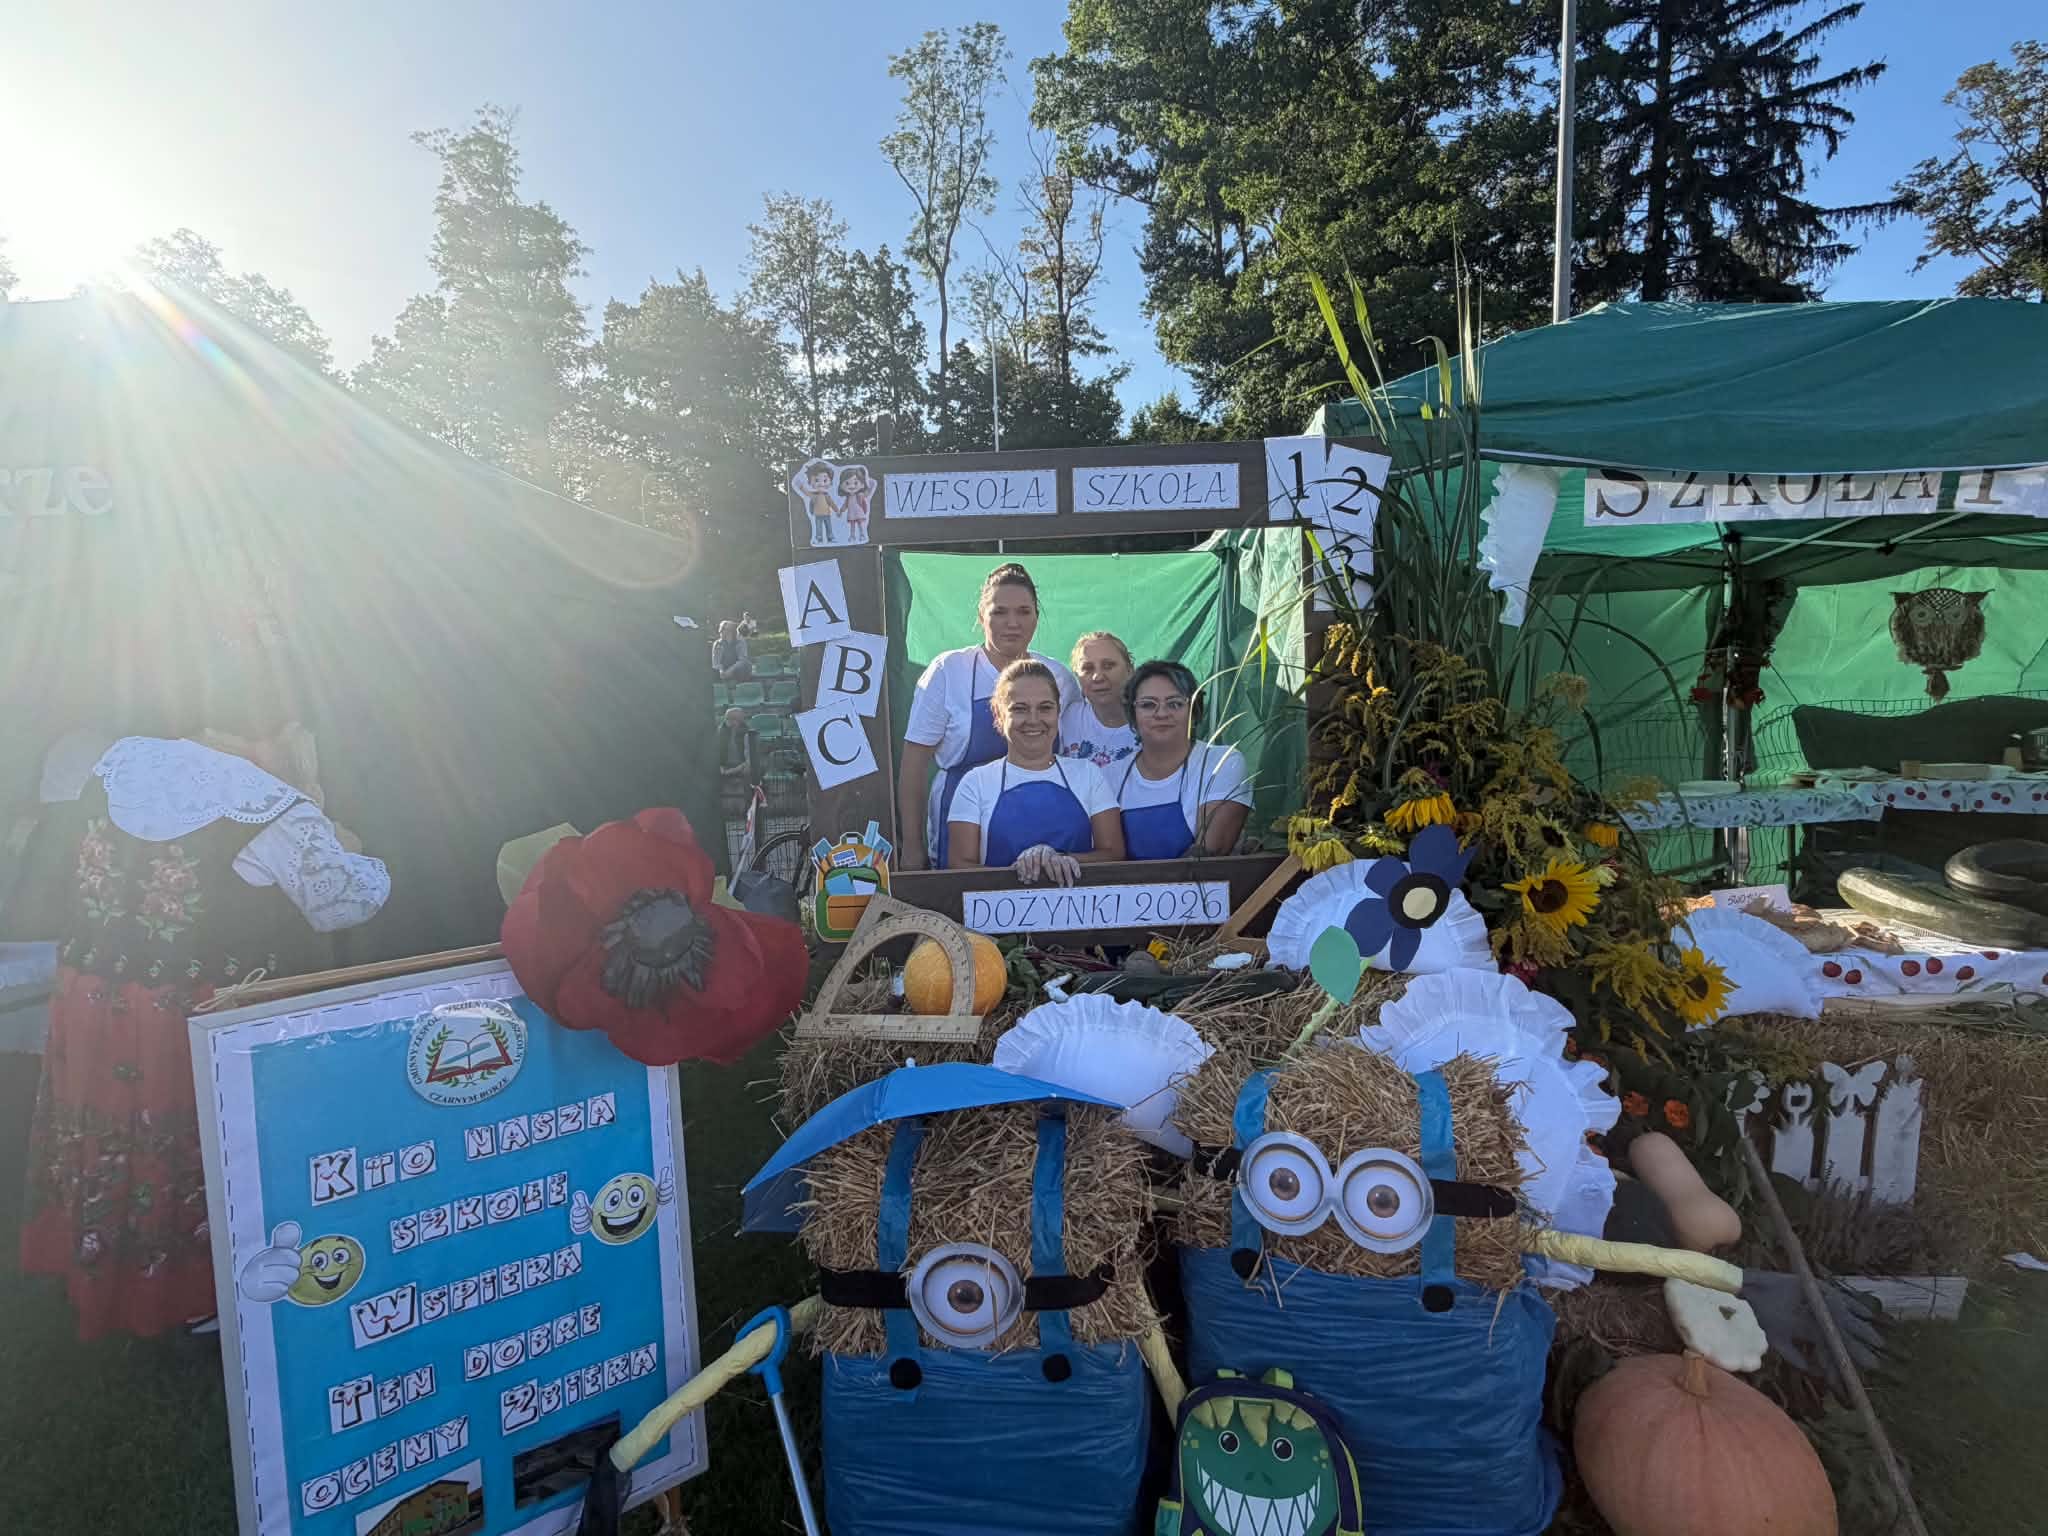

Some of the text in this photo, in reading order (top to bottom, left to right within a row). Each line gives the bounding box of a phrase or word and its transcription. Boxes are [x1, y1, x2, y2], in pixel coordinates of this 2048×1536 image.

[892, 471, 1231, 513] WESOŁA SZKOŁA
[1288, 450, 1310, 500] 1
[1330, 466, 1368, 516] 2
[797, 579, 845, 630] A
[831, 645, 873, 696] B
[816, 714, 862, 767] C
[1133, 888, 1222, 922] 2026
[466, 1096, 615, 1160] NASZA
[356, 1247, 581, 1340] WSPIERA
[332, 1306, 600, 1429] TEN DOBRE
[304, 1345, 657, 1511] OCENY ZBIERA
